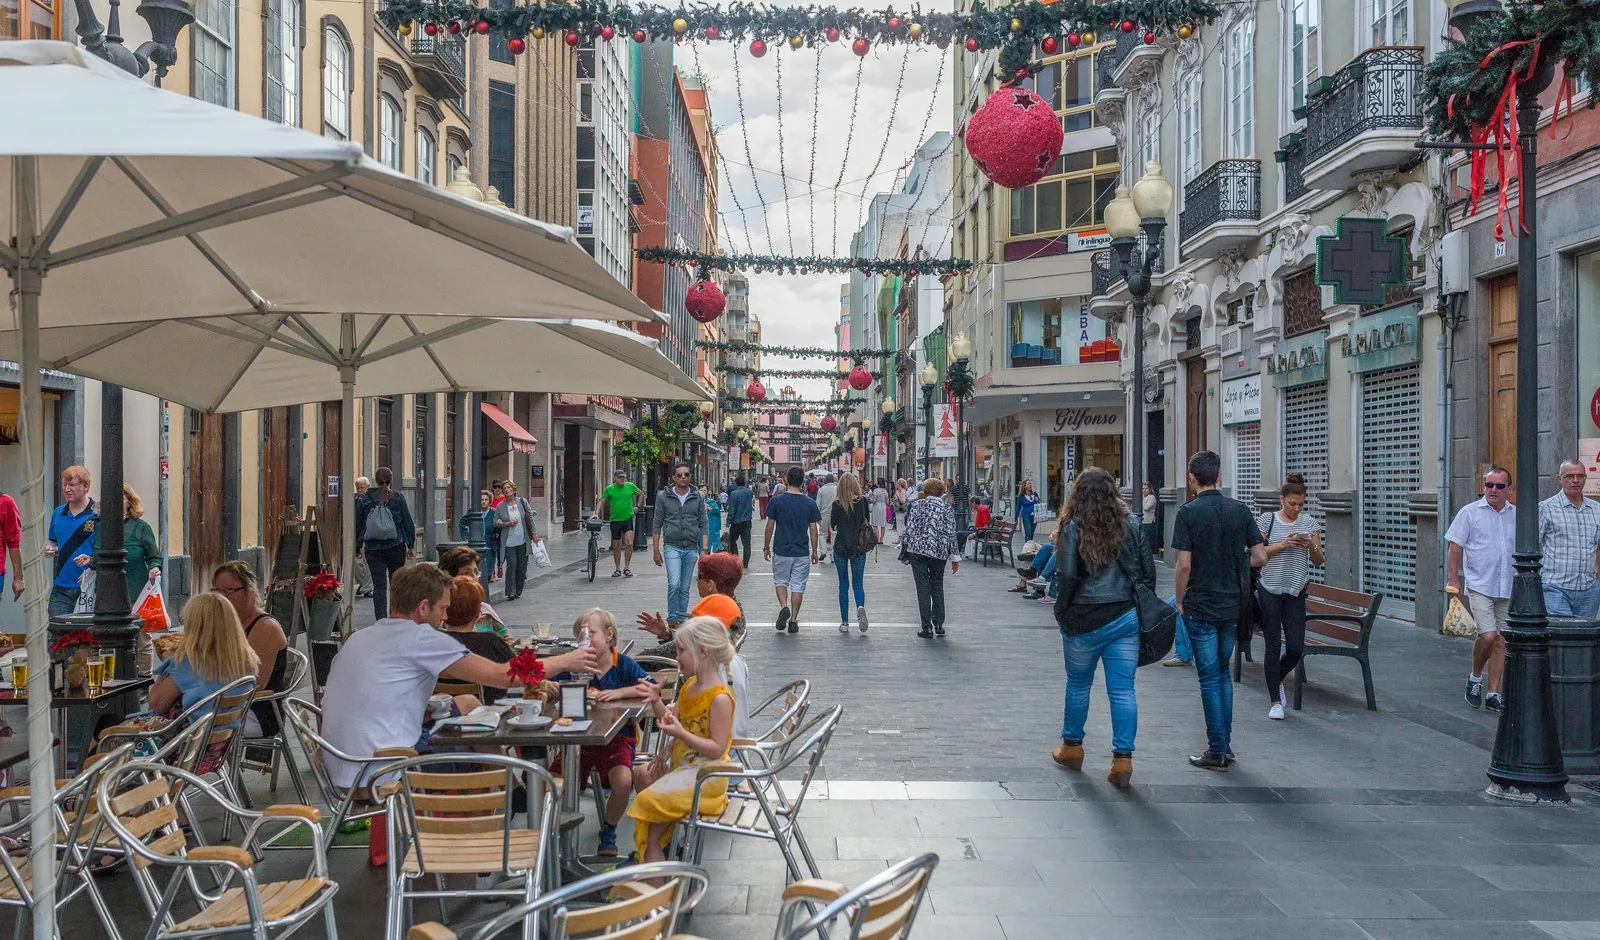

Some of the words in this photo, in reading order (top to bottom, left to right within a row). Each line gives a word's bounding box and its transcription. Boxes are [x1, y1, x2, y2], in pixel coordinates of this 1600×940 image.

[1085, 236, 1111, 245] inlingua
[1497, 244, 1504, 256] 67
[1080, 295, 1088, 346] REBA
[1054, 407, 1117, 433] Gilfonso
[1067, 435, 1075, 486] REBA
